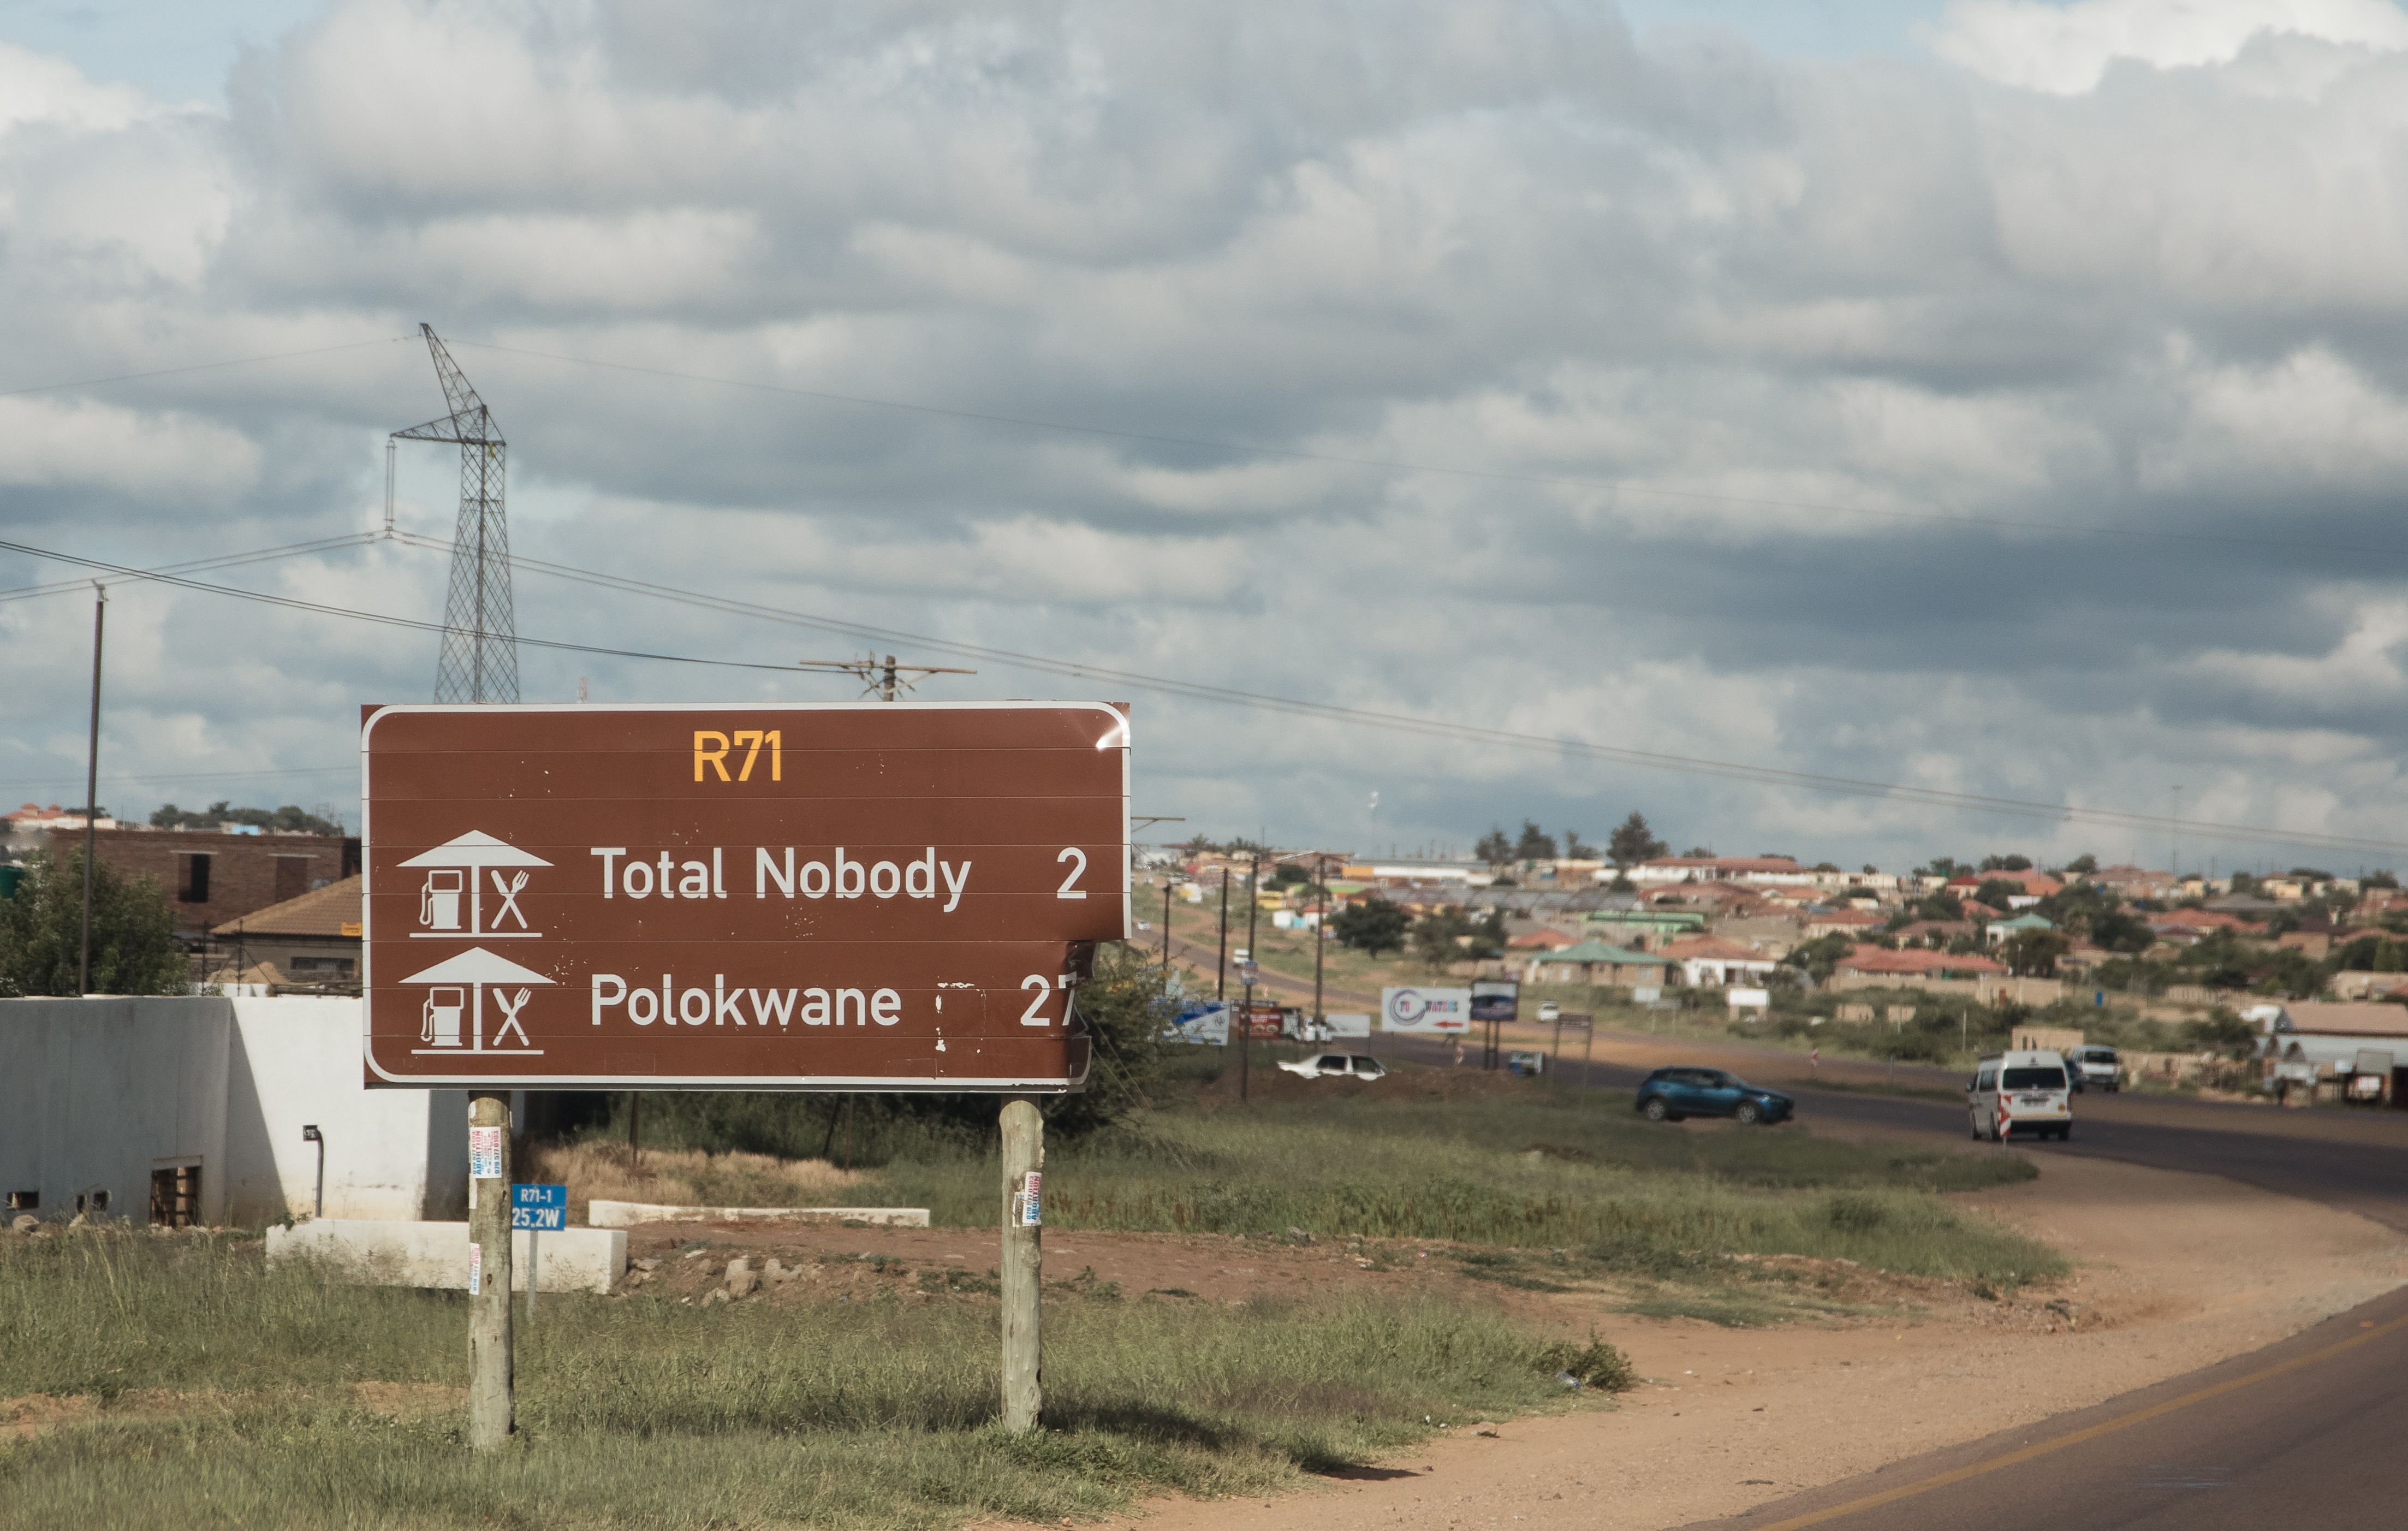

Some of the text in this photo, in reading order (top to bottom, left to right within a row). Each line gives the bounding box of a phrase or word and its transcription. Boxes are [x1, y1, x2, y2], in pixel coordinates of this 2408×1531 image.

[694, 731, 781, 781] R71
[591, 847, 1086, 912] Total Nobody 2
[592, 971, 1077, 1026] Polokwane 27
[512, 1207, 560, 1228] 25.2W
[521, 1188, 551, 1203] R71-1
